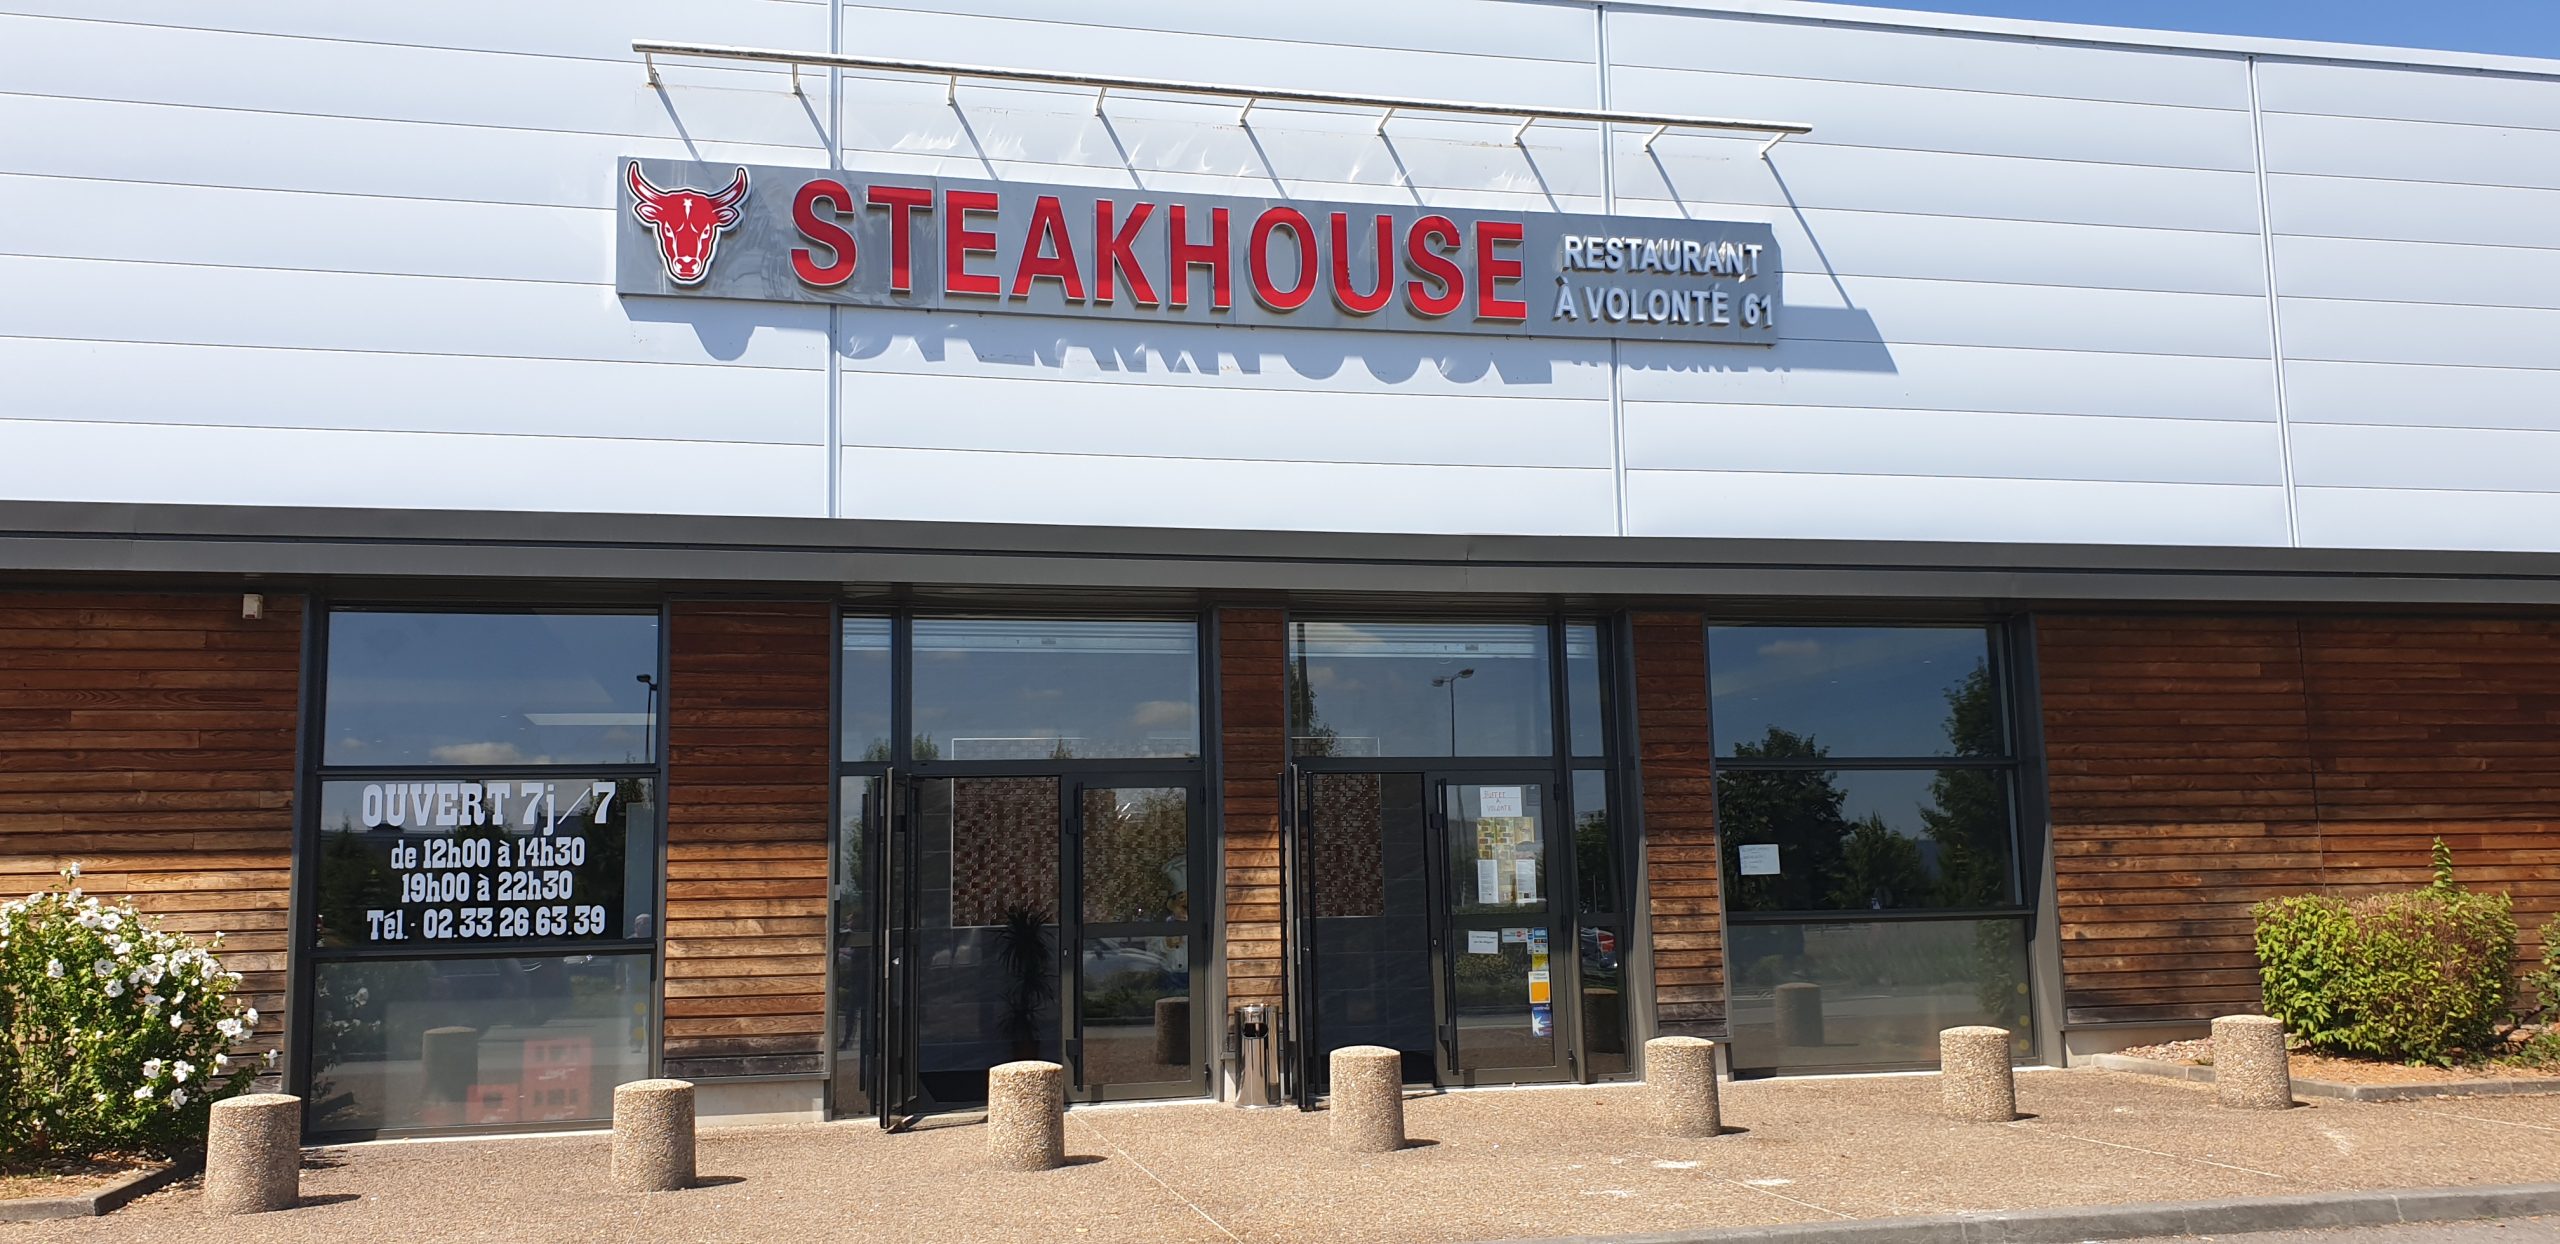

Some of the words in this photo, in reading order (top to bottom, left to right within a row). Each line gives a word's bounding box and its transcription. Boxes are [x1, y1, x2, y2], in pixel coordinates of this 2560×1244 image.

[790, 178, 1528, 322] STEAKHOUSE
[1561, 235, 1763, 277] RESTAURANT
[1553, 276, 1578, 319] À
[1584, 283, 1730, 327] VOLONTÉ
[1743, 293, 1773, 328] 61
[362, 782, 511, 828] OUVERT
[390, 839, 417, 870] de
[423, 837, 491, 869] 12h00
[497, 839, 512, 868] à
[517, 836, 586, 867] 14h30
[401, 871, 470, 904] 19h00
[476, 873, 491, 902] à
[497, 870, 573, 902] 22h30
[423, 904, 606, 939] 02.33.26.63.39
